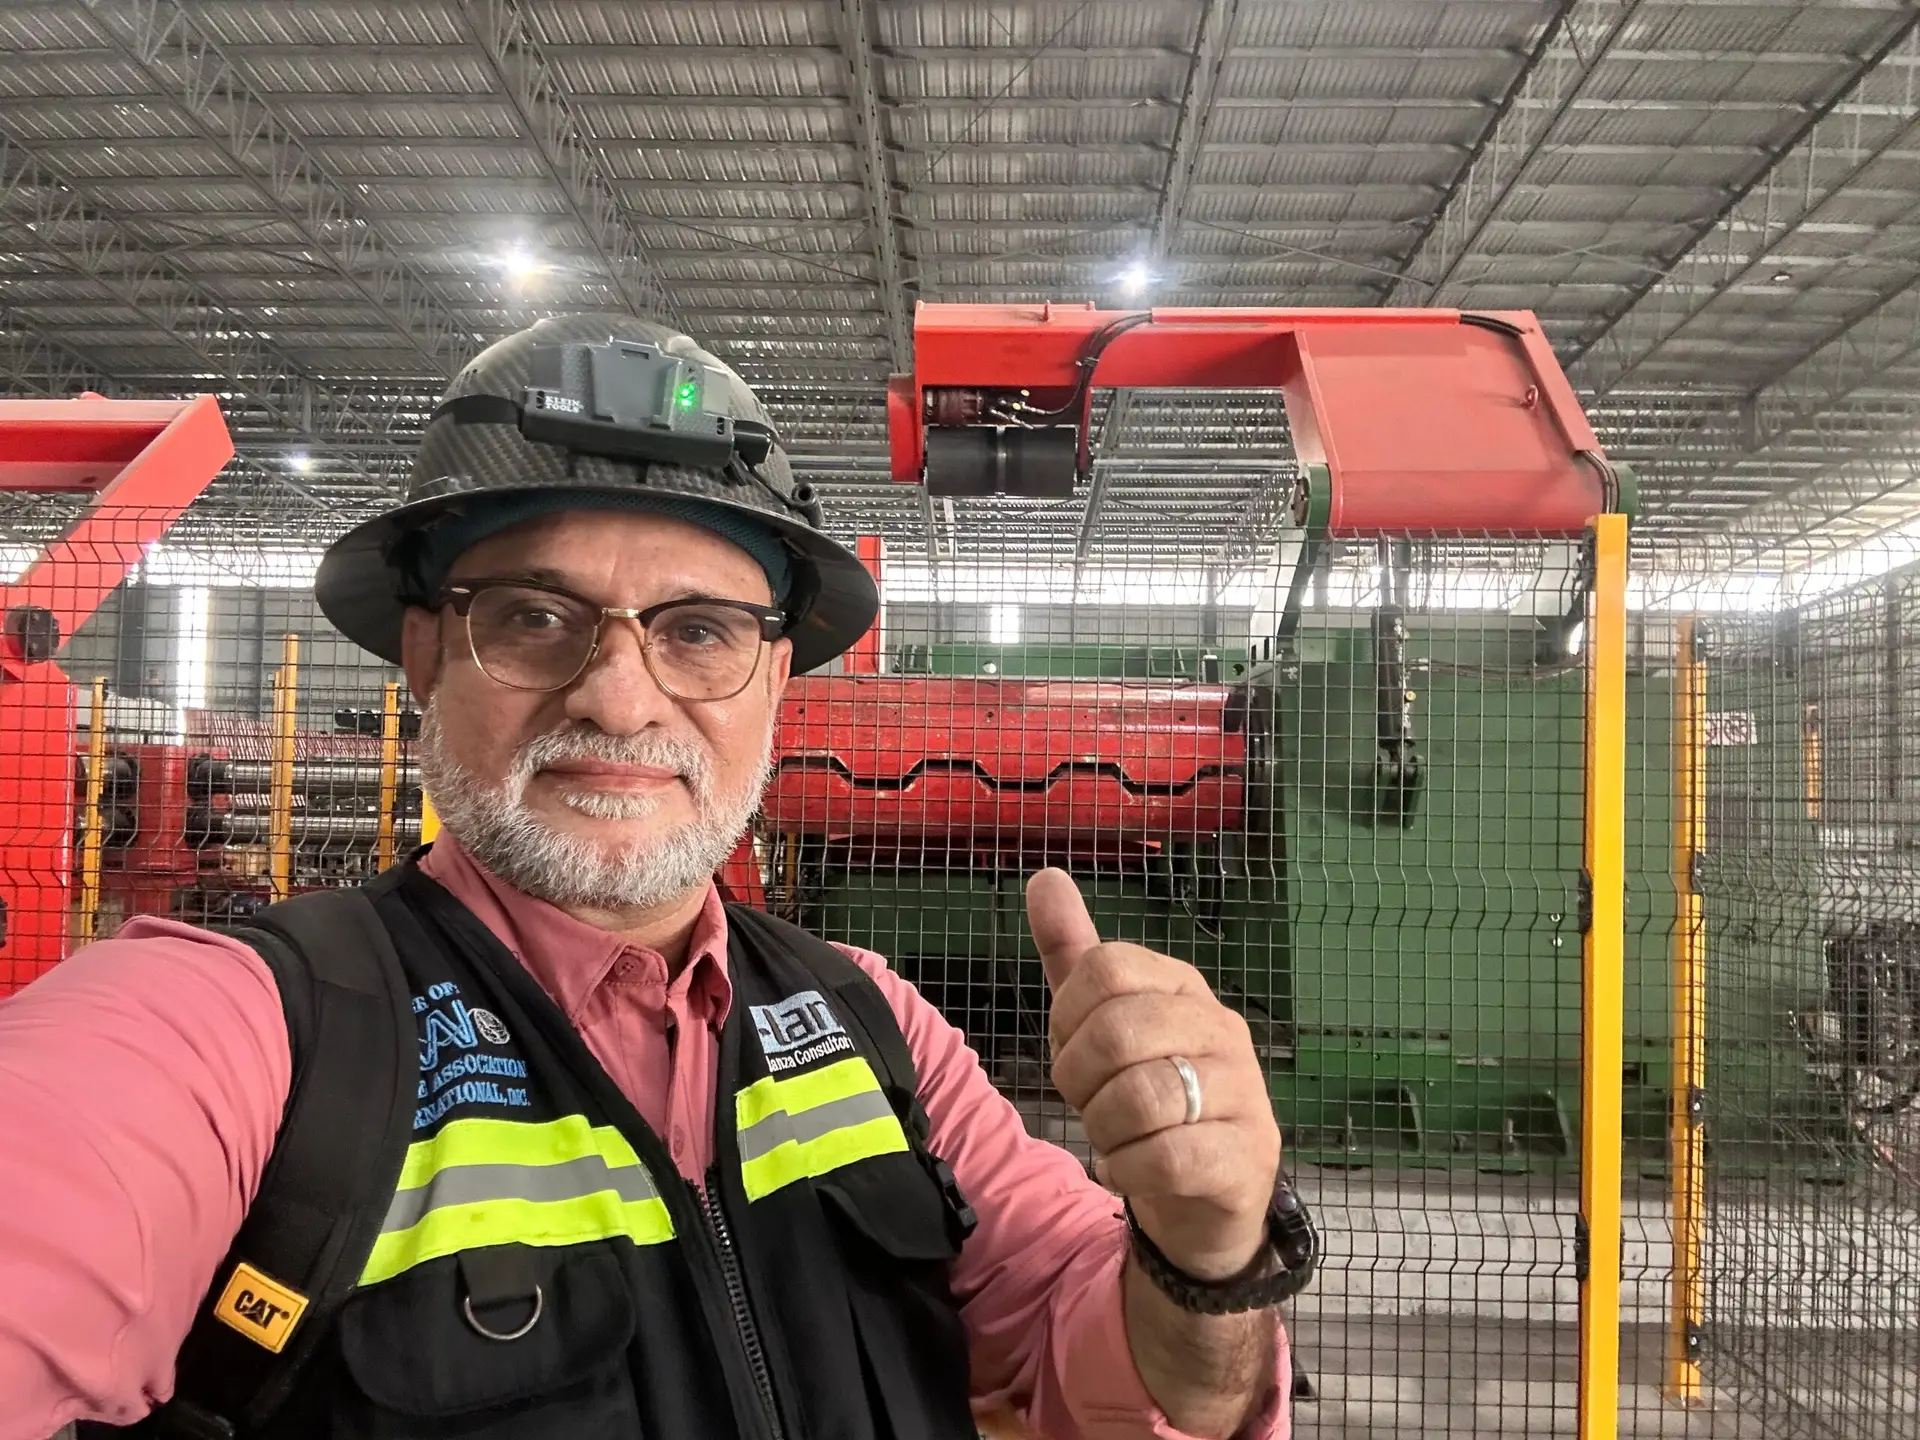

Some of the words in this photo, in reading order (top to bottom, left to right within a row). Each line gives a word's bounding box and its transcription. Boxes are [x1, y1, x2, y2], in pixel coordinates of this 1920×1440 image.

[544, 395, 581, 407] KLEIN
[545, 402, 580, 414] TOOLS
[432, 1054, 527, 1093] ASSOCIATION
